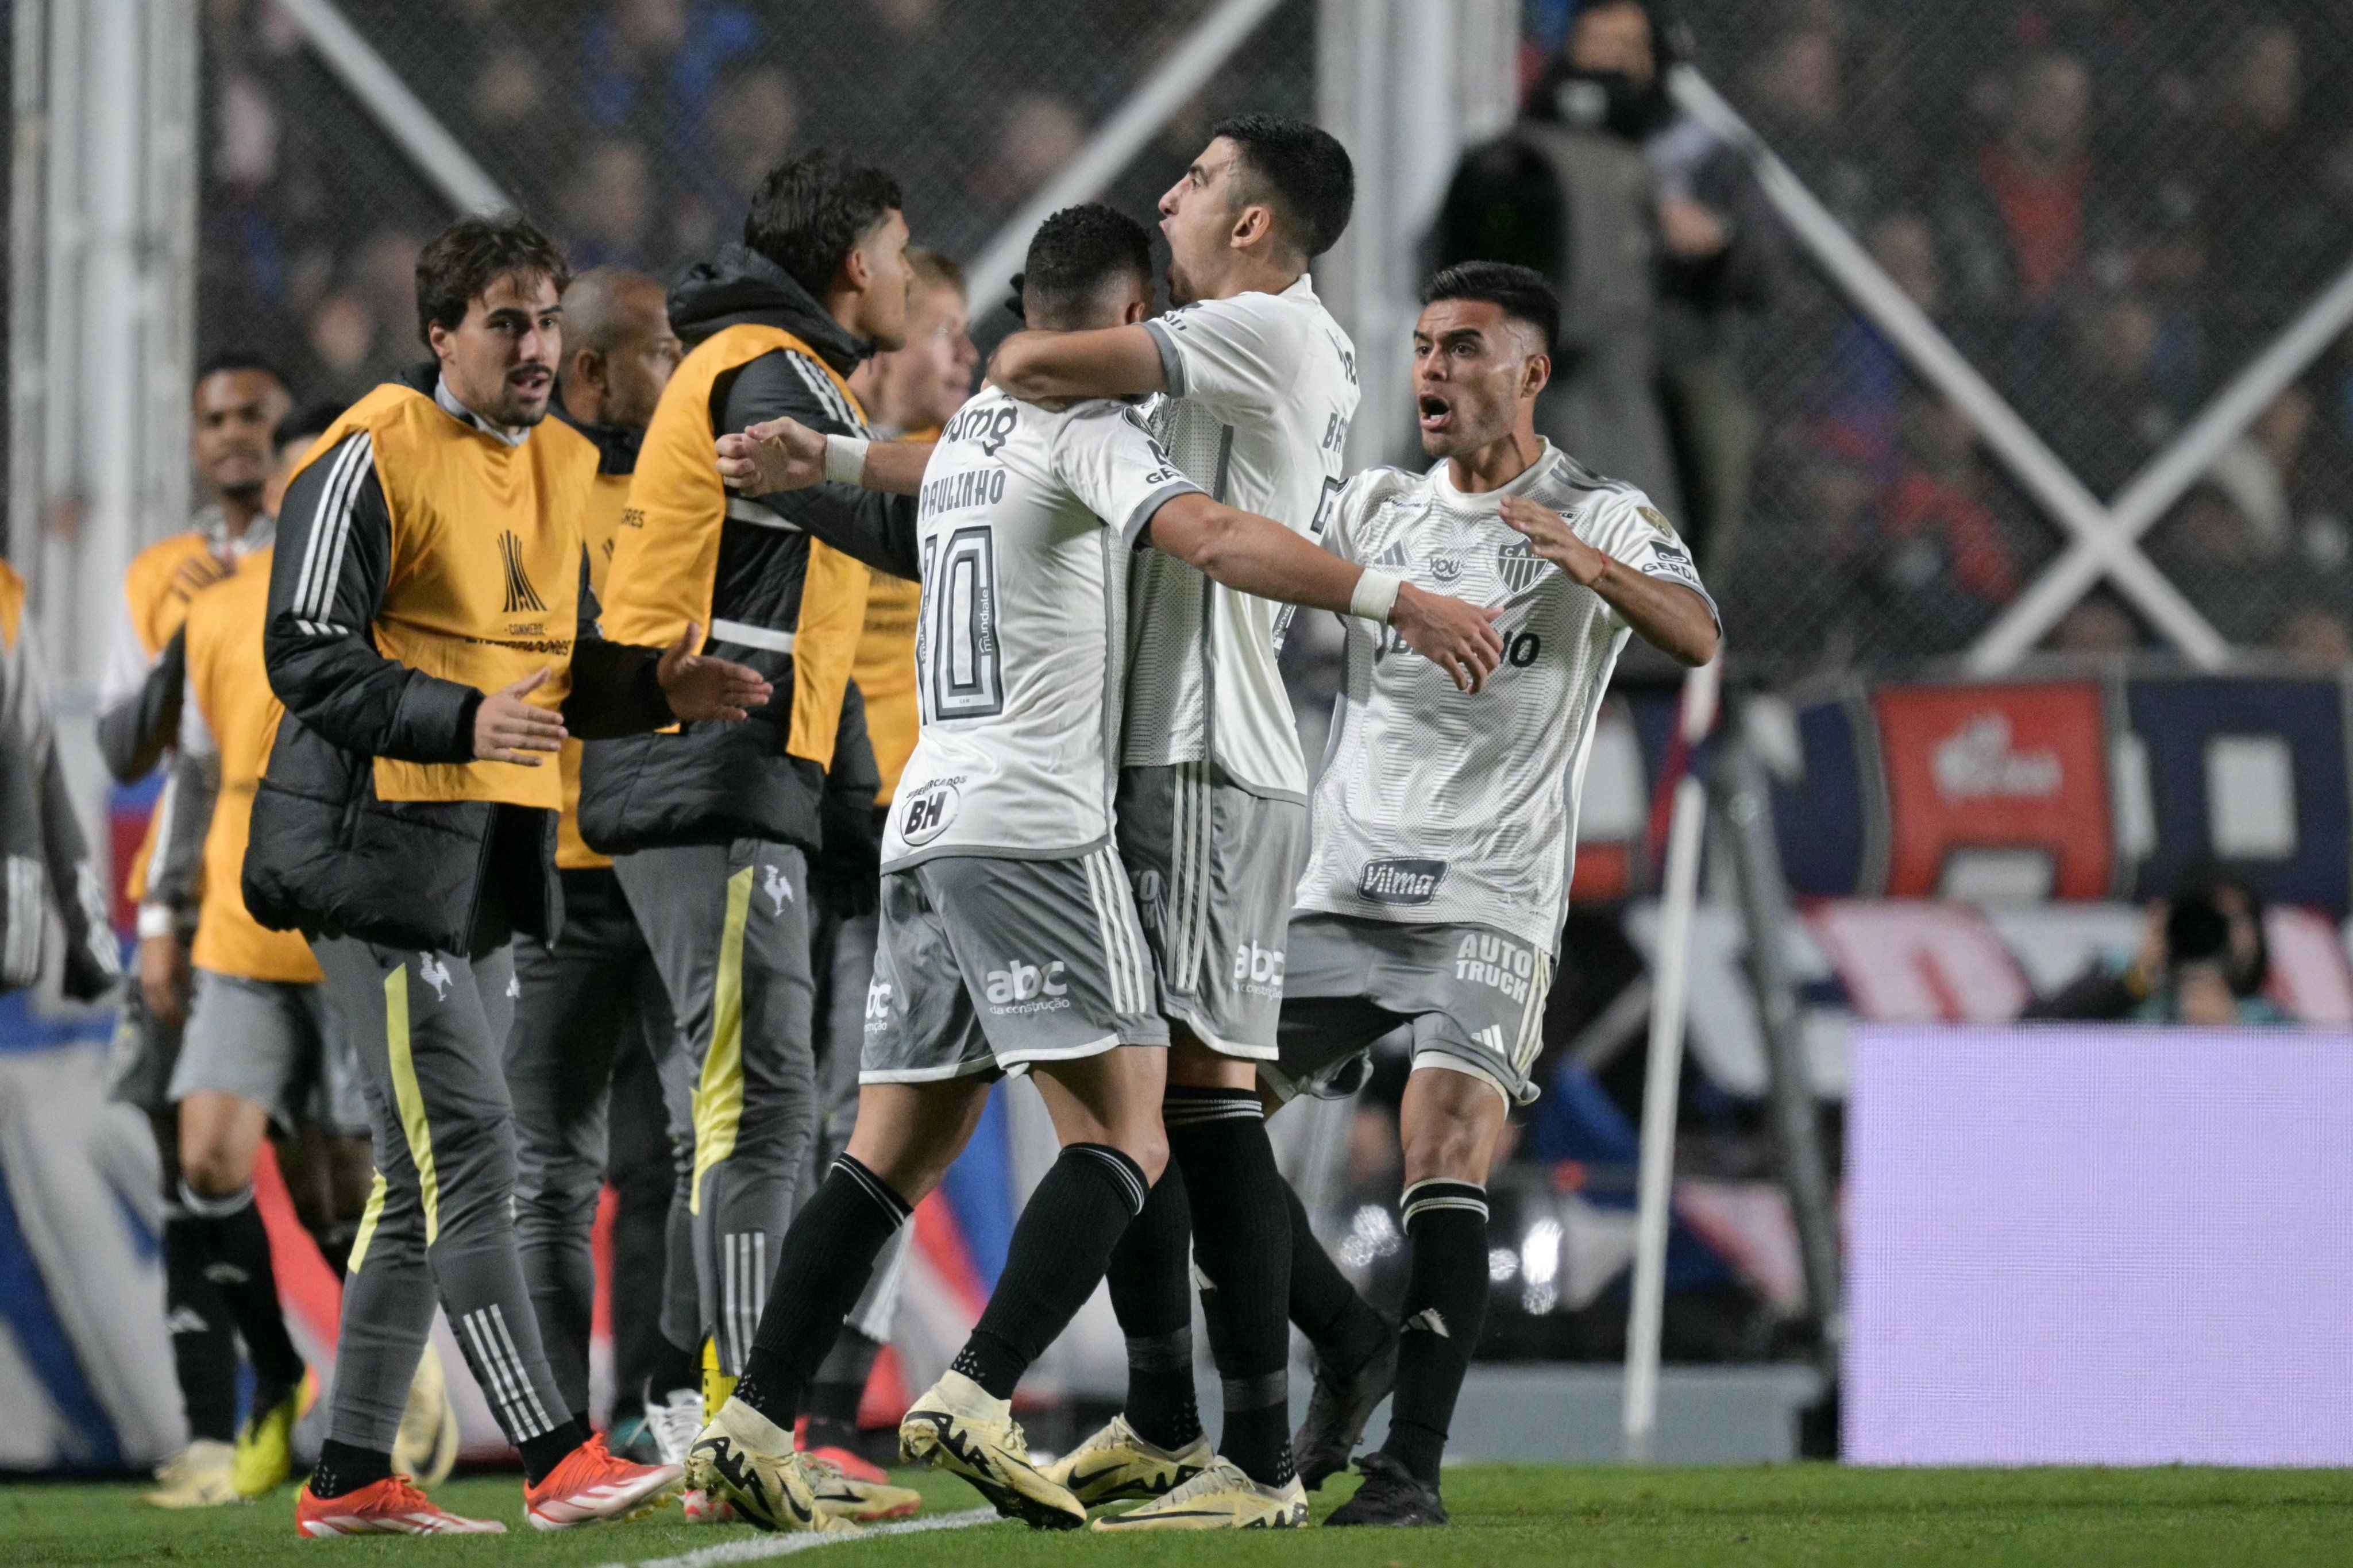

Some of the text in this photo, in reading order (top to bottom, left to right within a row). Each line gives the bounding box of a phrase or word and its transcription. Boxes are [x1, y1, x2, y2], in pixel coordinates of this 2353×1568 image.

[921, 469, 1006, 521] PAULINHO
[916, 525, 1005, 727] 10
[979, 589, 992, 654] mundiale
[904, 791, 948, 836] BH
[1364, 864, 1435, 895] Vilma
[1457, 934, 1533, 979] AUTO
[986, 960, 1067, 1004] abc
[1456, 960, 1529, 1004] TRUCK
[989, 997, 1070, 1016] da construção
